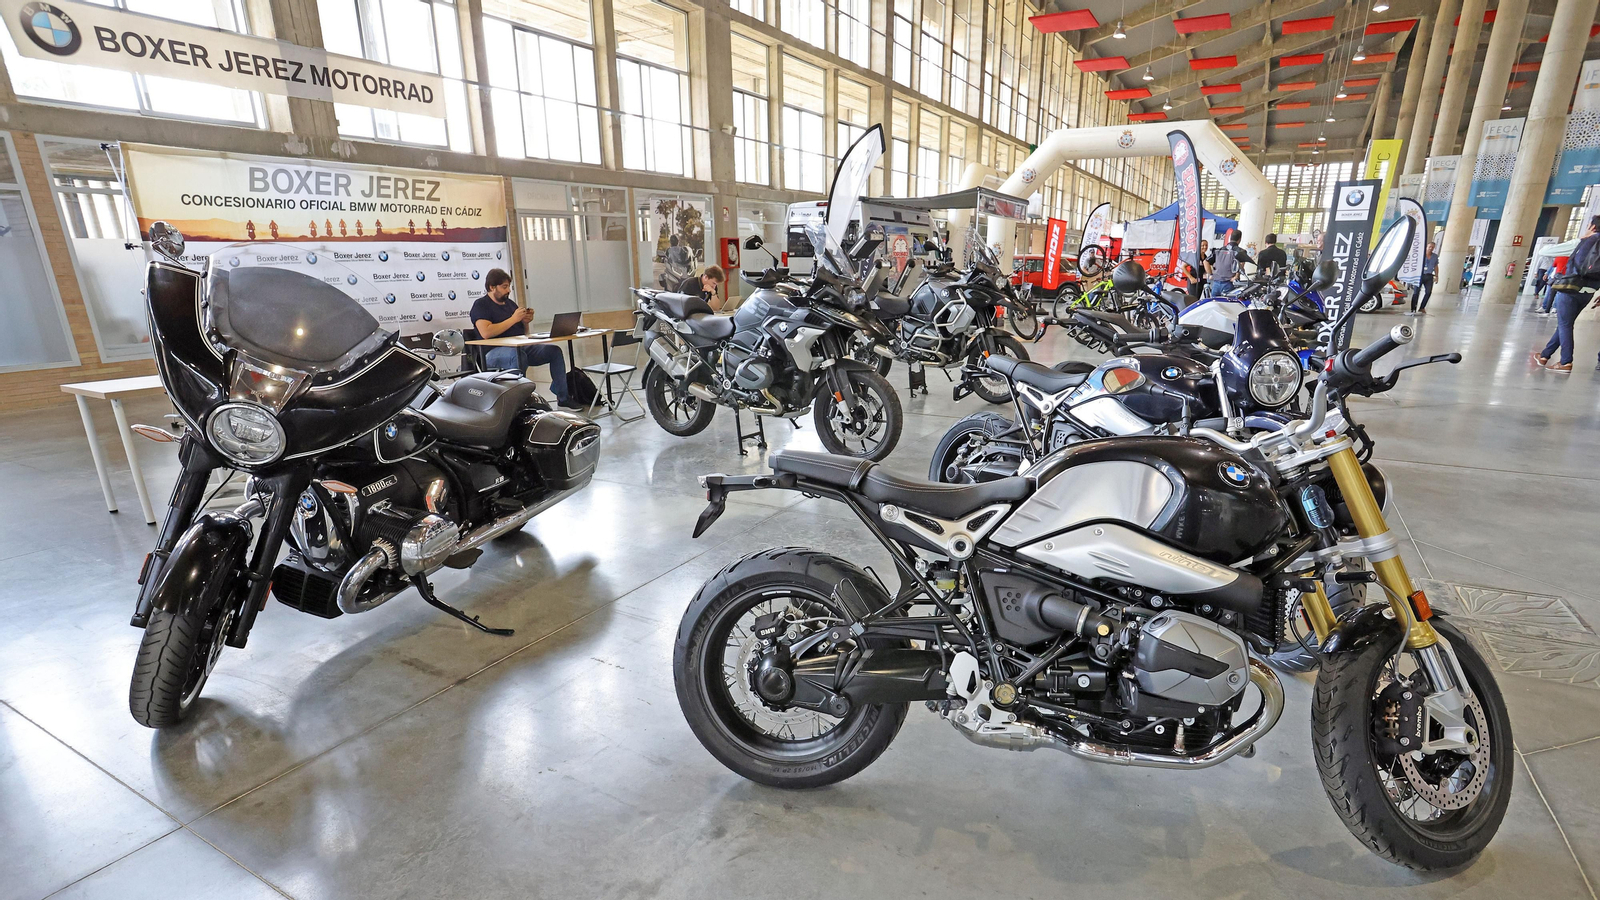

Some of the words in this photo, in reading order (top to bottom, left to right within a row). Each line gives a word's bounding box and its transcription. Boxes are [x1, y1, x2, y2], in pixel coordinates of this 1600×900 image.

[94, 25, 213, 69] BOXER
[218, 49, 306, 84] JEREZ
[310, 64, 434, 104] MOTORRAD
[1485, 124, 1519, 134] IFECA
[1432, 159, 1457, 167] IFECA
[248, 166, 353, 197] BOXER
[361, 175, 441, 202] JEREZ
[180, 194, 296, 210] CONCESIONARIO
[299, 199, 347, 212] OFICIAL
[349, 201, 377, 212] BMW
[380, 203, 438, 215] MOTORRAD
[440, 206, 453, 216] EN
[455, 205, 482, 217] CÁDIZ
[367, 480, 392, 494] 1800cc
[760, 627, 776, 636] BMW
[1415, 706, 1423, 738] brembo
[828, 706, 881, 766] MICHELIN
